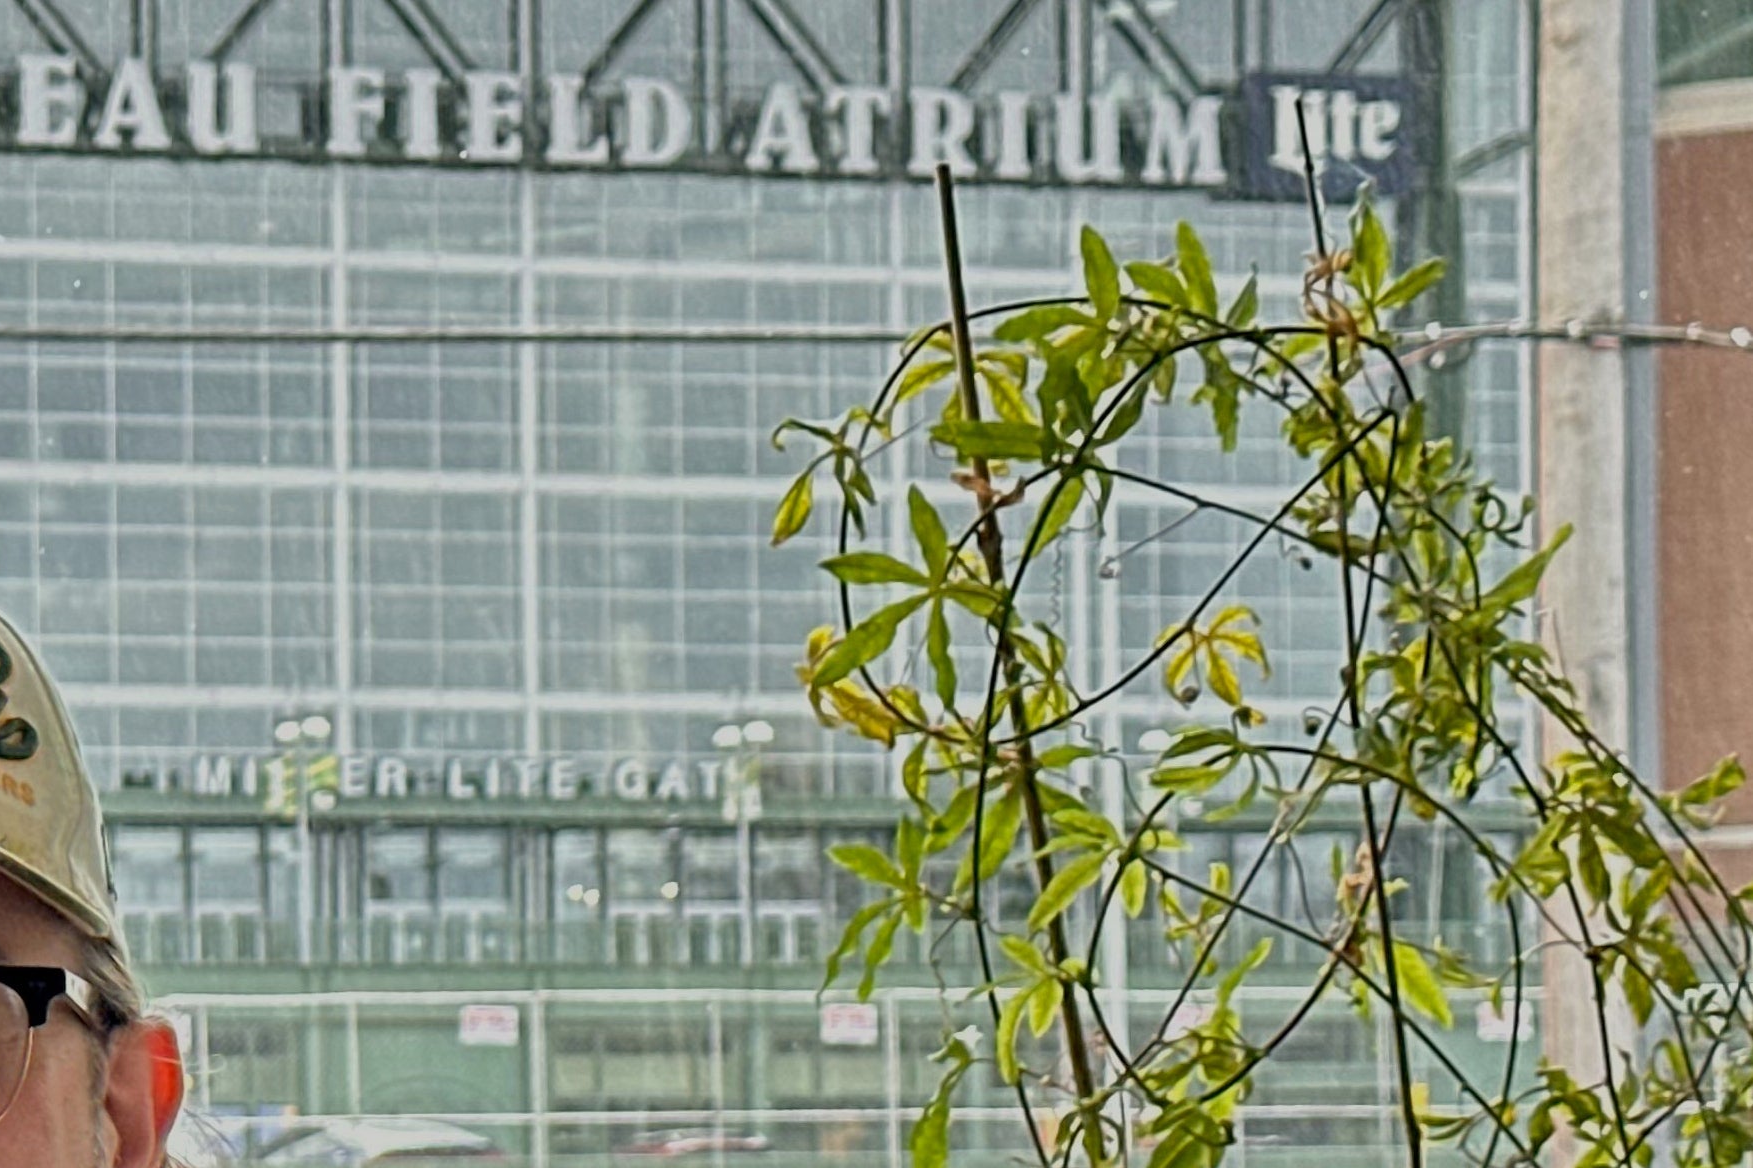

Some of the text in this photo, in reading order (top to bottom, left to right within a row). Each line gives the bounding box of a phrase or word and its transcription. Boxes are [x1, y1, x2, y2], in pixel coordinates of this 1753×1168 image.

[326, 67, 693, 167] FIELD
[745, 83, 1227, 187] ATRIUM
[1268, 85, 1401, 178] Lite
[195, 754, 759, 800] MIER LITE GAT
